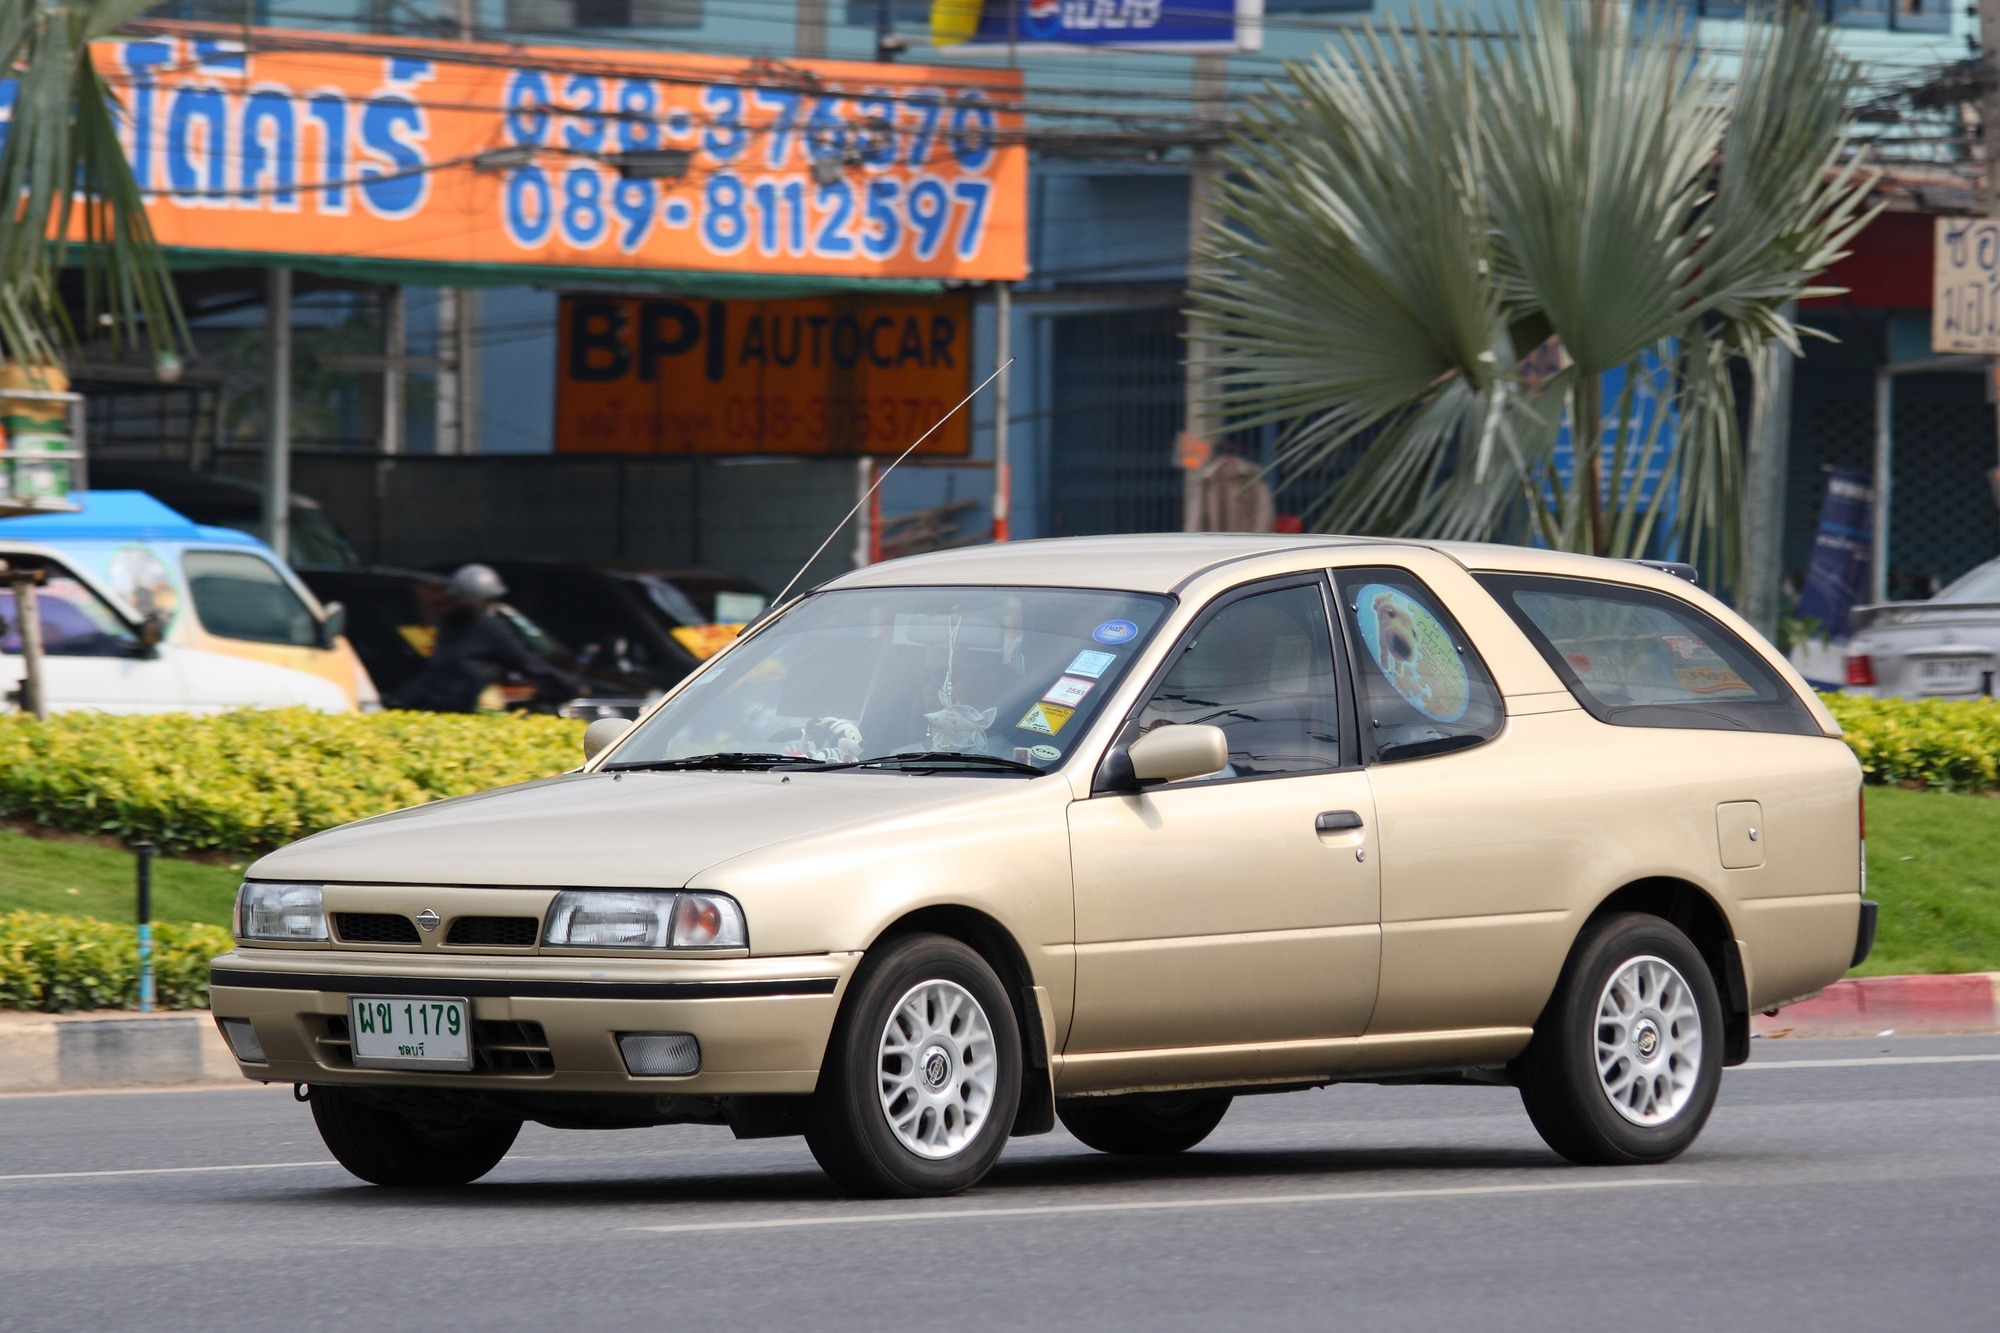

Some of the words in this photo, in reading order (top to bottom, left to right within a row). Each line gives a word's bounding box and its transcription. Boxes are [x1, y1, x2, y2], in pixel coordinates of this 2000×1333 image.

[506, 163, 993, 257] 089-8112597
[569, 302, 726, 383] BPI
[739, 313, 957, 369] AUTOCAR
[358, 1002, 393, 1034] ผข
[404, 1003, 461, 1036] 1179
[398, 1042, 425, 1057] ชลบรี
